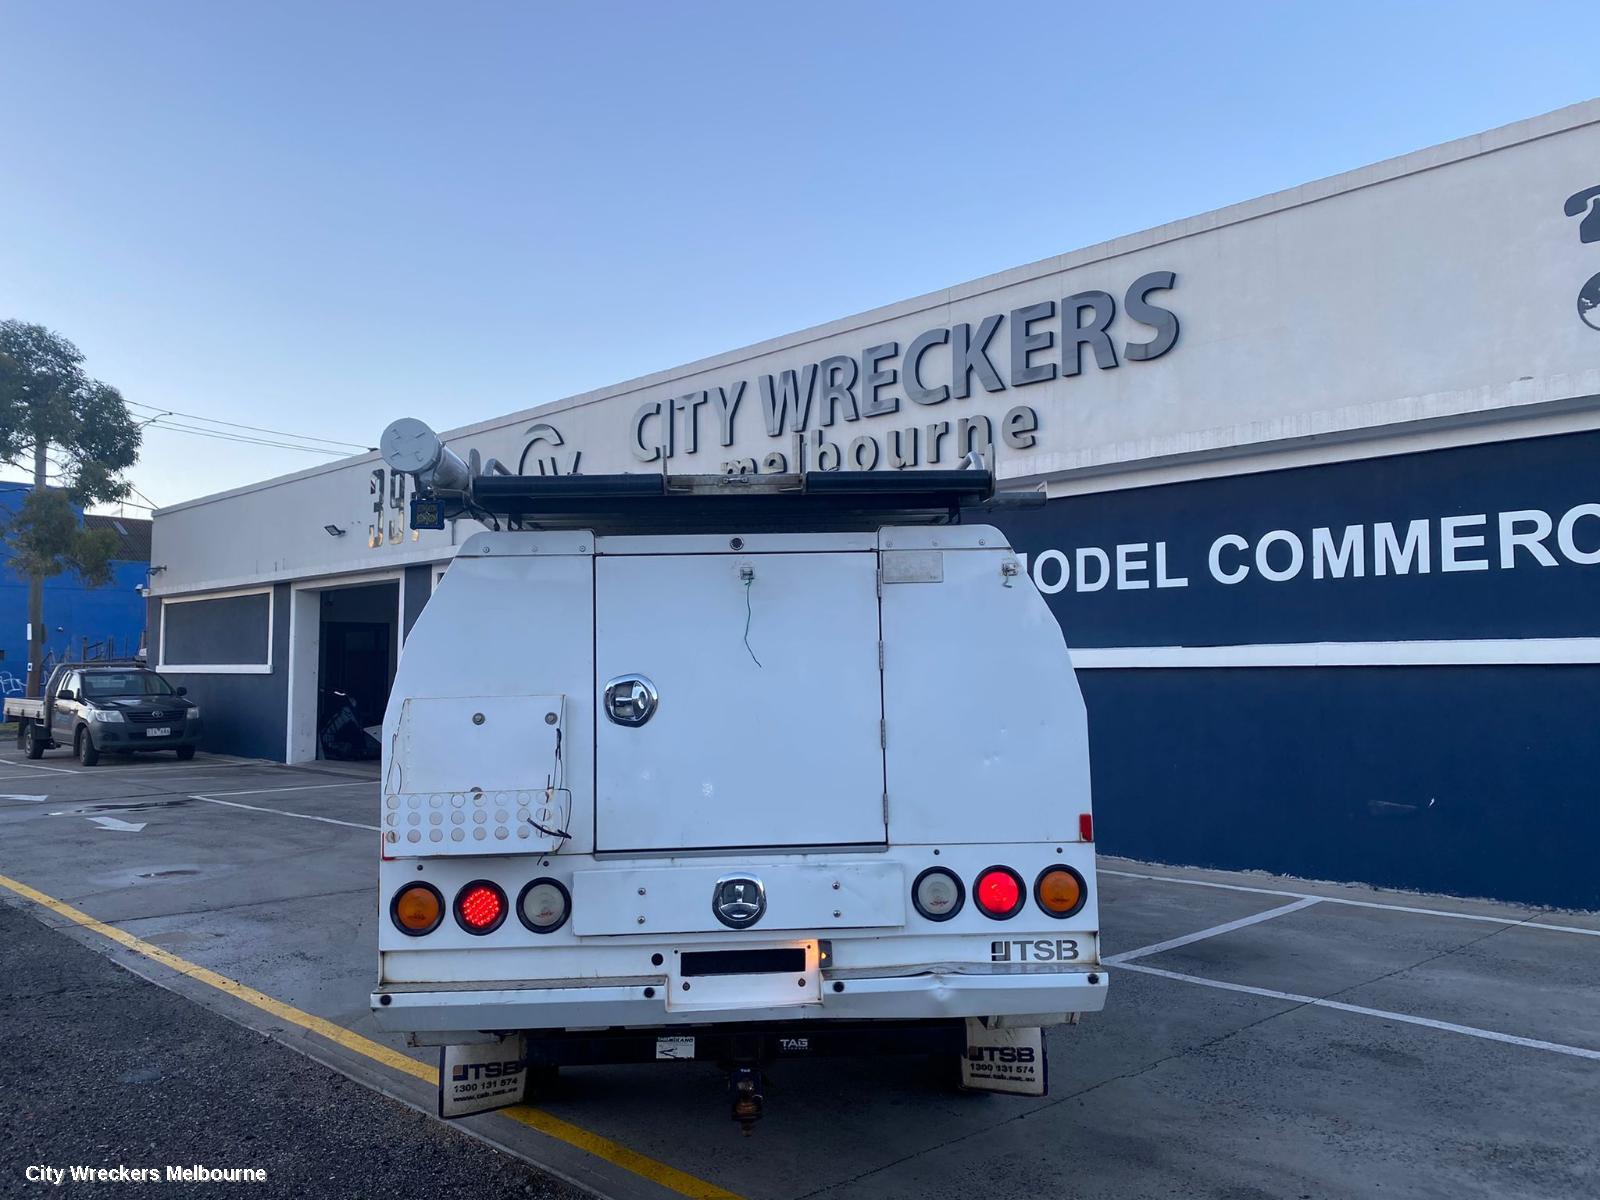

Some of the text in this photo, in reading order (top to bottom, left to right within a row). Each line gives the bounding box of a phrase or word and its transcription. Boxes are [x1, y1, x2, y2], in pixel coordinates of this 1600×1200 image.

[631, 271, 1180, 462] CITY WRECKERS
[368, 469, 419, 548] 39
[1015, 503, 1600, 594] ODEL COMMERC
[780, 1038, 808, 1047] TAG
[454, 1077, 518, 1093] 1300 131 574
[970, 1063, 1034, 1074] 1300 131 574
